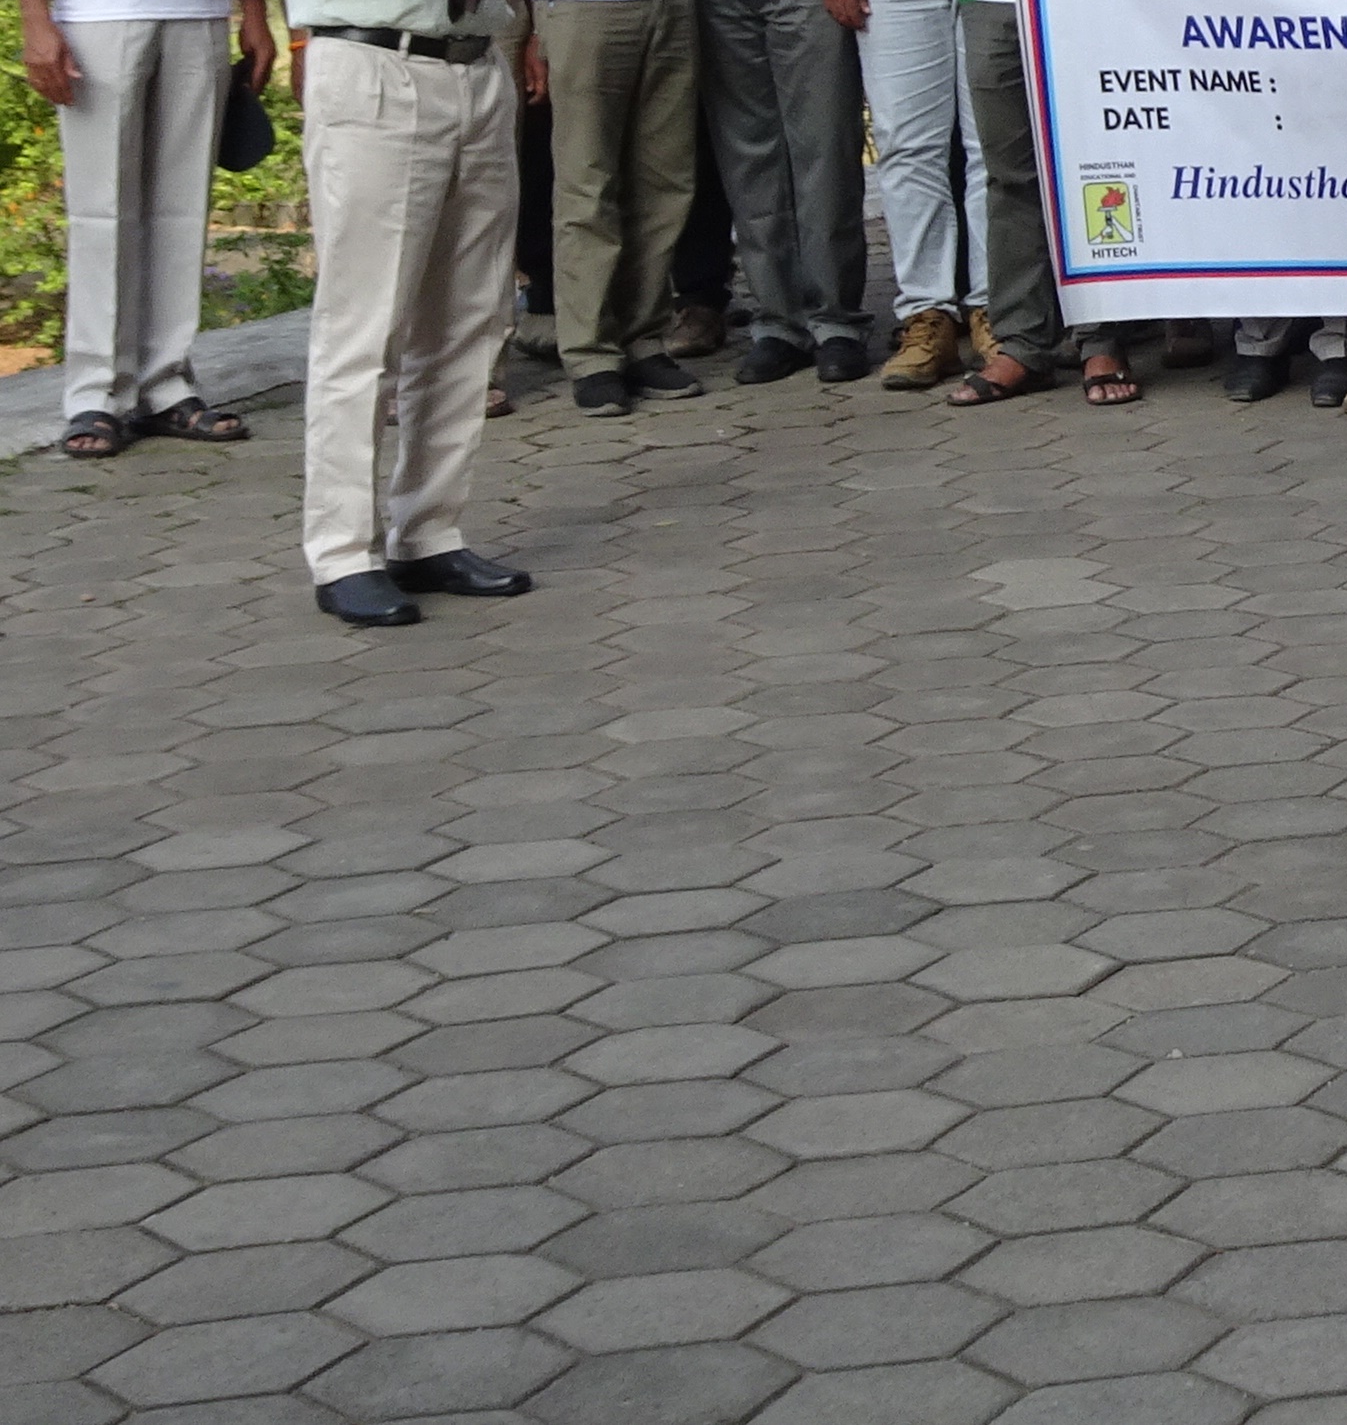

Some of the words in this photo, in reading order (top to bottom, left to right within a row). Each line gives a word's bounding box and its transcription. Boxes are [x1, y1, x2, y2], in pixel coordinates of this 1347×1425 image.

[1100, 70, 1182, 93] EVENT
[1190, 69, 1262, 93] NAME
[1103, 107, 1171, 131] DATE
[1079, 161, 1135, 170] HINDUSTHAN
[1091, 247, 1138, 259] HITECH
